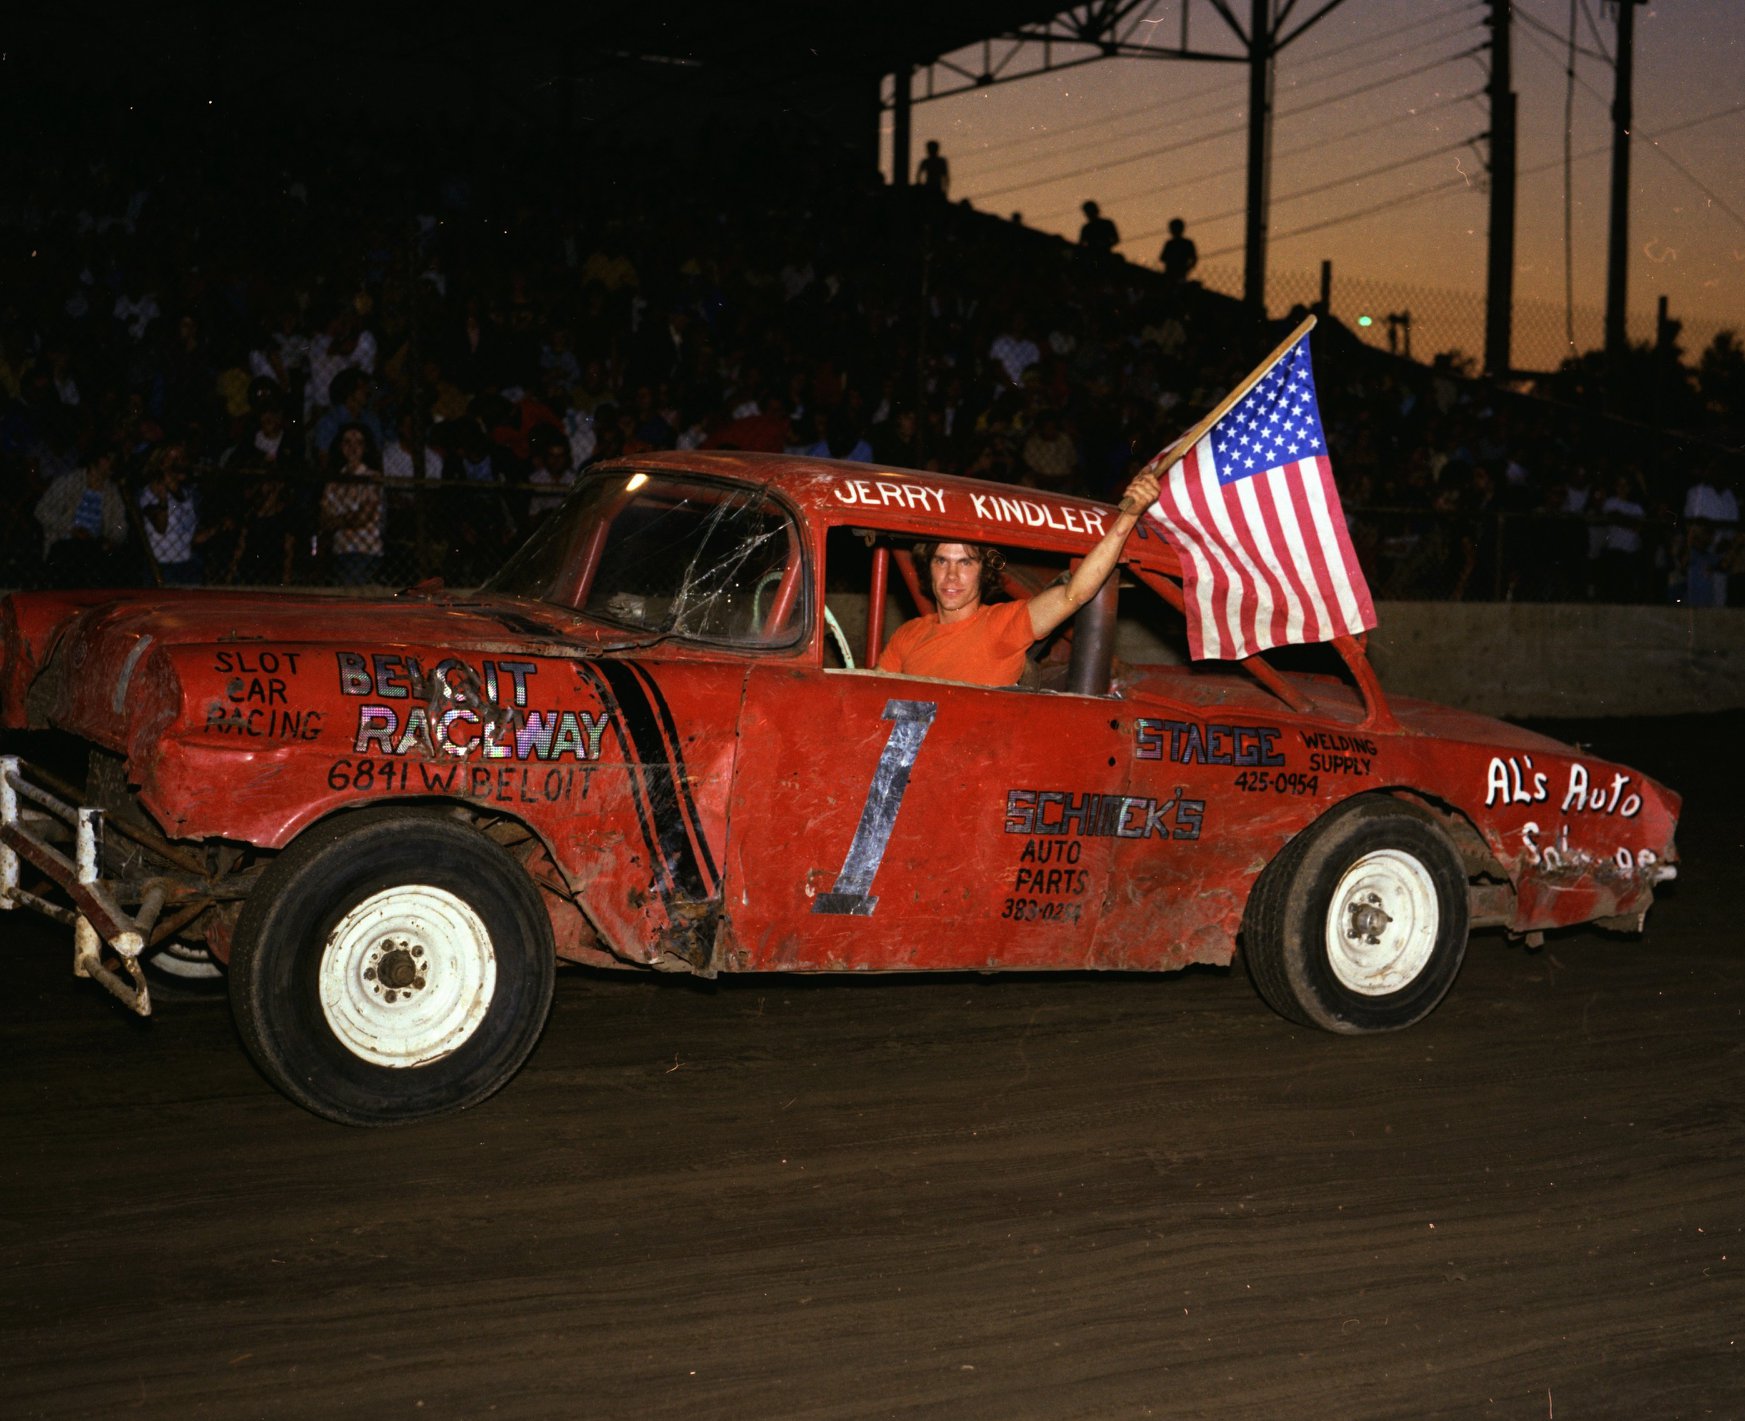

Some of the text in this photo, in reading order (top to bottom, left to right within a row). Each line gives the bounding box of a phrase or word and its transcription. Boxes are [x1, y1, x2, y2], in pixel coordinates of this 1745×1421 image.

[834, 480, 946, 513] JERRY
[969, 493, 1106, 537] KINDLER
[214, 651, 301, 675] SLOT
[336, 652, 538, 707] BELOIT
[226, 677, 288, 706] CAR
[203, 703, 323, 741] RACING
[353, 704, 611, 761] RACEWAY
[1135, 718, 1286, 767] STAEGE
[1300, 731, 1378, 756] WELDING
[1309, 753, 1372, 776] SUPPLY
[327, 759, 600, 804] 6841 W BELOIT
[1233, 772, 1319, 796] 425-0954
[1560, 763, 1643, 818] Auto
[1020, 838, 1082, 865] AUTO
[1014, 868, 1089, 895] PARTS
